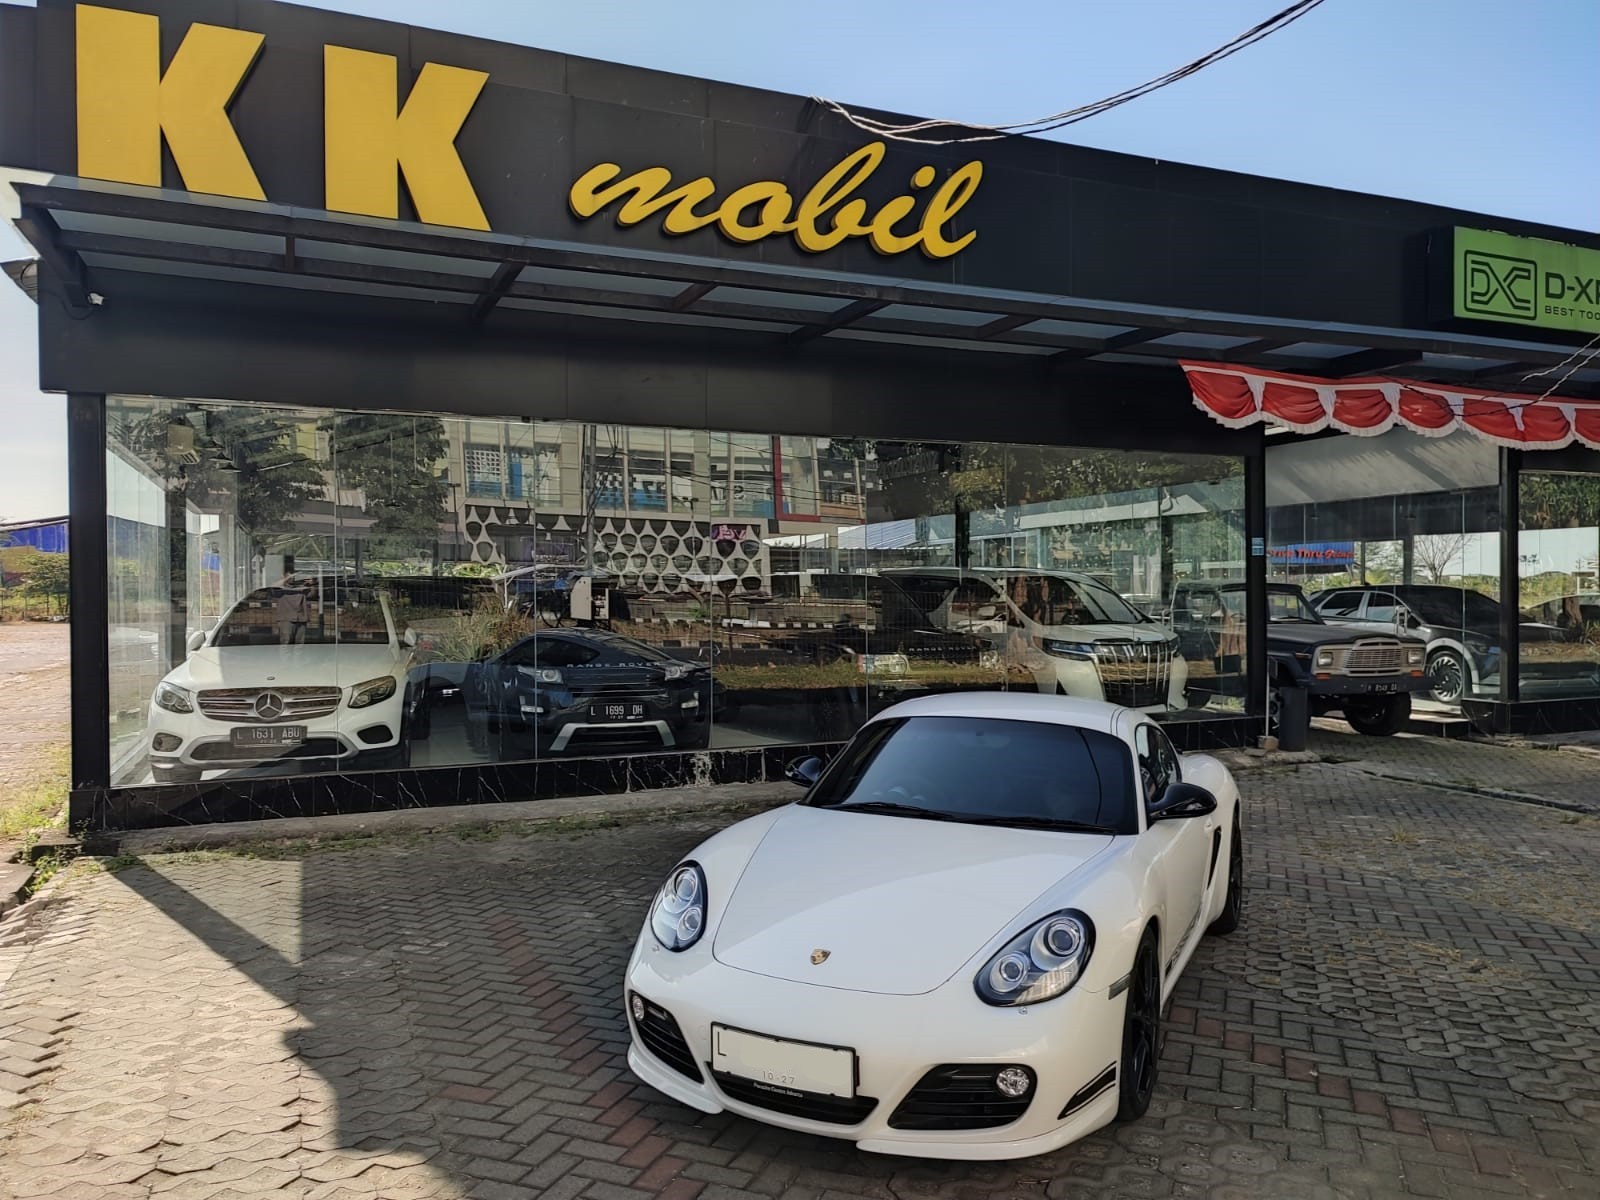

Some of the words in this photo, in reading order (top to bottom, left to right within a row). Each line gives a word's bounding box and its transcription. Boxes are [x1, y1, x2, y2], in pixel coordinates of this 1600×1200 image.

[569, 141, 983, 258] mobil
[1544, 305, 1575, 317] BEST
[590, 706, 596, 716] L
[605, 705, 624, 716] 1699
[632, 705, 643, 715] DH
[252, 727, 274, 739] 1631
[282, 727, 300, 739] ABU
[717, 1031, 727, 1057] L
[762, 1070, 795, 1085] 10-27
